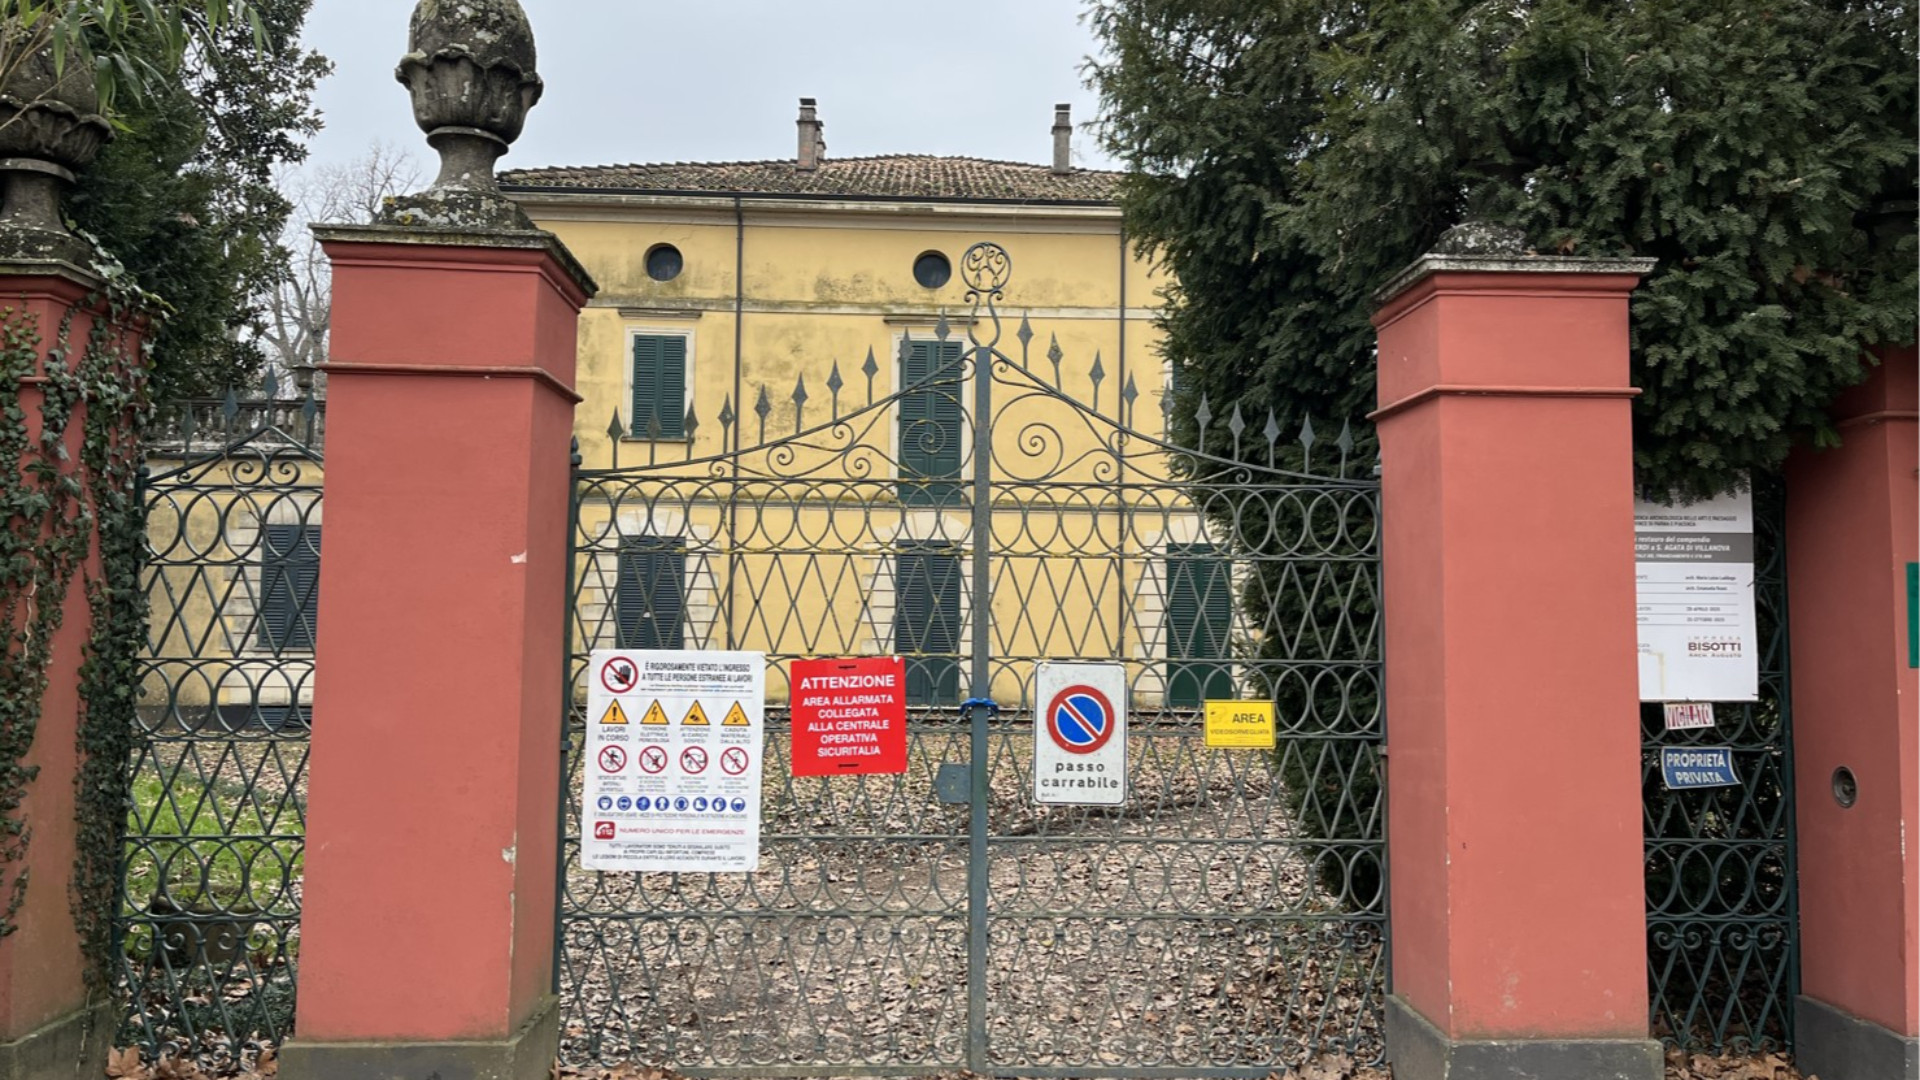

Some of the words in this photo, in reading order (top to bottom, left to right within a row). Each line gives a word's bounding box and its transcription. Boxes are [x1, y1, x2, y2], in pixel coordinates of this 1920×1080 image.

[1688, 642, 1742, 651] BISOTTI
[650, 662, 696, 671] RIGOROSAMENTE
[696, 663, 718, 672] VIETATO
[719, 663, 751, 672] L'INGRESSO
[672, 673, 698, 681] PERSONE
[699, 674, 726, 682] ESTRANEE
[734, 674, 752, 682] LAVORI
[800, 674, 895, 690] ATTENZIONE
[802, 696, 830, 707] AREA
[832, 694, 894, 706] ALLARMATA
[818, 708, 879, 719] COLLEGATA
[1232, 713, 1266, 724] AREA
[1667, 704, 1712, 727] VIGILATO
[808, 722, 834, 732] ALLA
[836, 720, 890, 731] CENTRALE
[820, 733, 878, 744] OPERATIVA
[817, 746, 881, 757] SICURITALIA
[1055, 762, 1105, 773] passo
[1041, 777, 1118, 788] carrabile
[1675, 772, 1726, 784] PRIVATA
